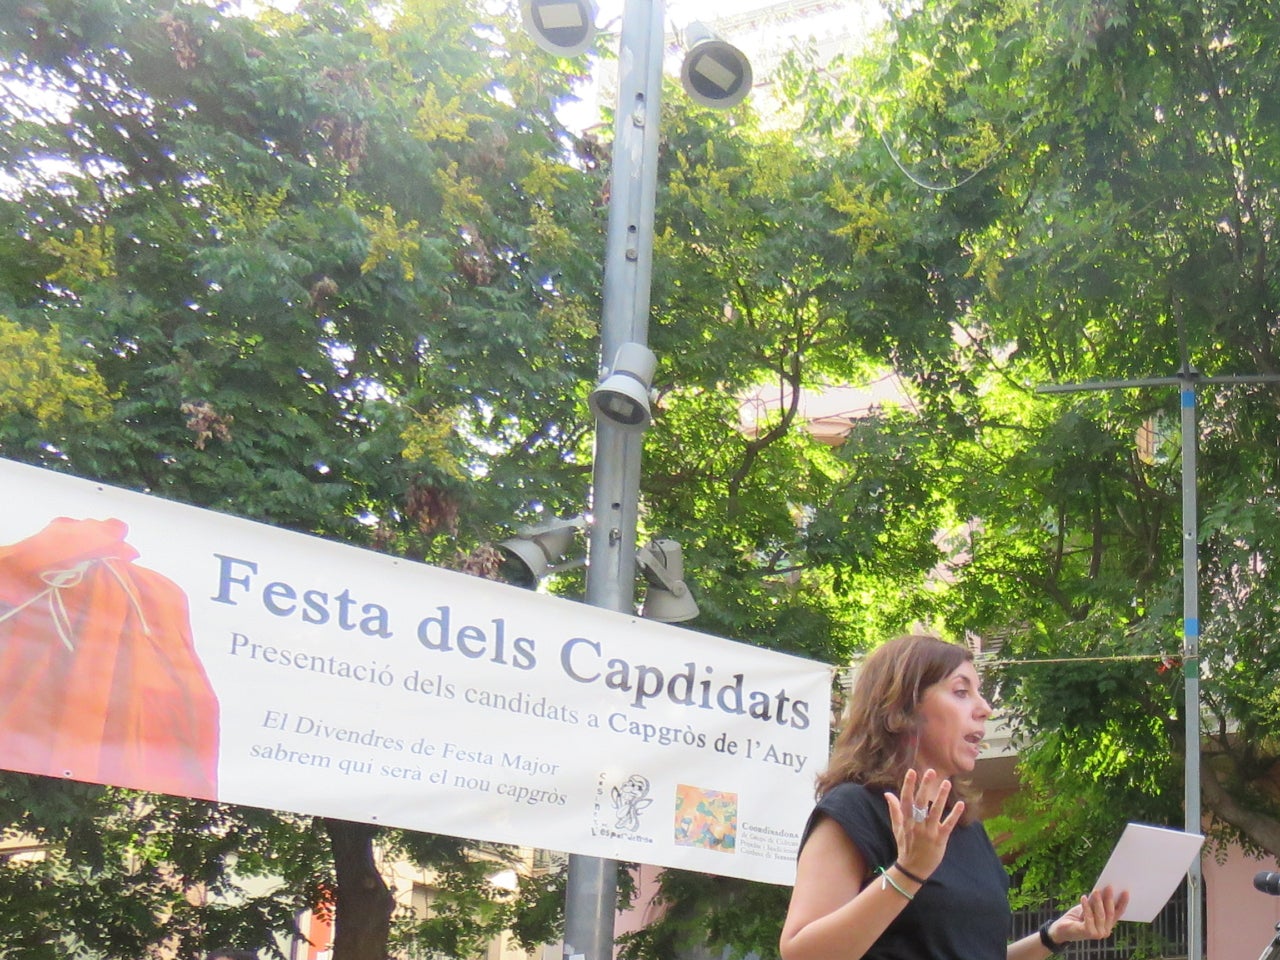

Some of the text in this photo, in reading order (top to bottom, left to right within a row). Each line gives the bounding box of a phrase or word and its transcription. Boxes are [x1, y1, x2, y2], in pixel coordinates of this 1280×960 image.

[210, 553, 811, 730] Festa dels Capdidats
[230, 632, 394, 687] Presentació
[403, 670, 456, 699] dels
[464, 688, 579, 725] candidats
[587, 713, 599, 728] a
[608, 712, 706, 748] Capgròs
[714, 733, 738, 755] de
[250, 743, 568, 807] sabrem qui serà el nou capgròs
[262, 710, 560, 776] El Divendres de Festa Major
